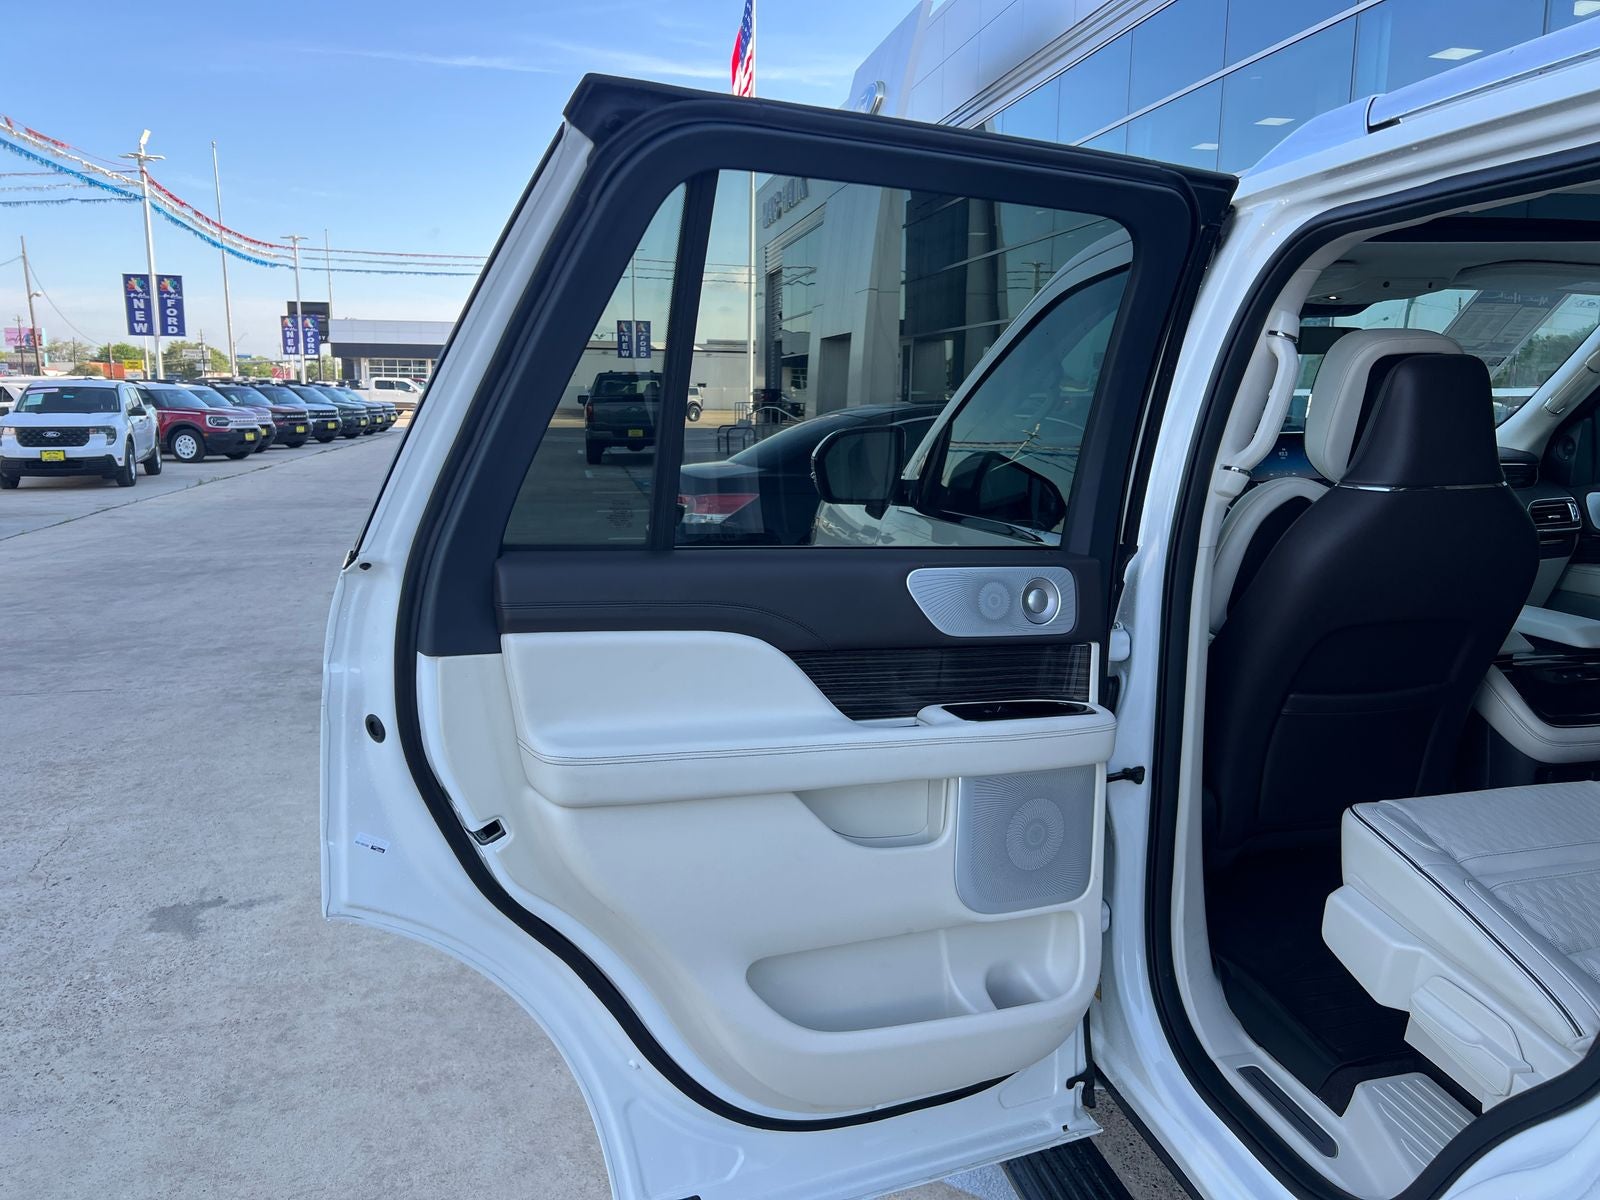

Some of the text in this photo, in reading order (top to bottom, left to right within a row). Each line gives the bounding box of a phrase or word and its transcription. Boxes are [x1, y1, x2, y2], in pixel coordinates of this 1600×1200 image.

[132, 298, 148, 333] NEW
[166, 299, 179, 334] FORD
[286, 330, 296, 353] NEW
[306, 331, 315, 354] FORD
[621, 335, 630, 357] NEW
[639, 335, 647, 357] FORD
